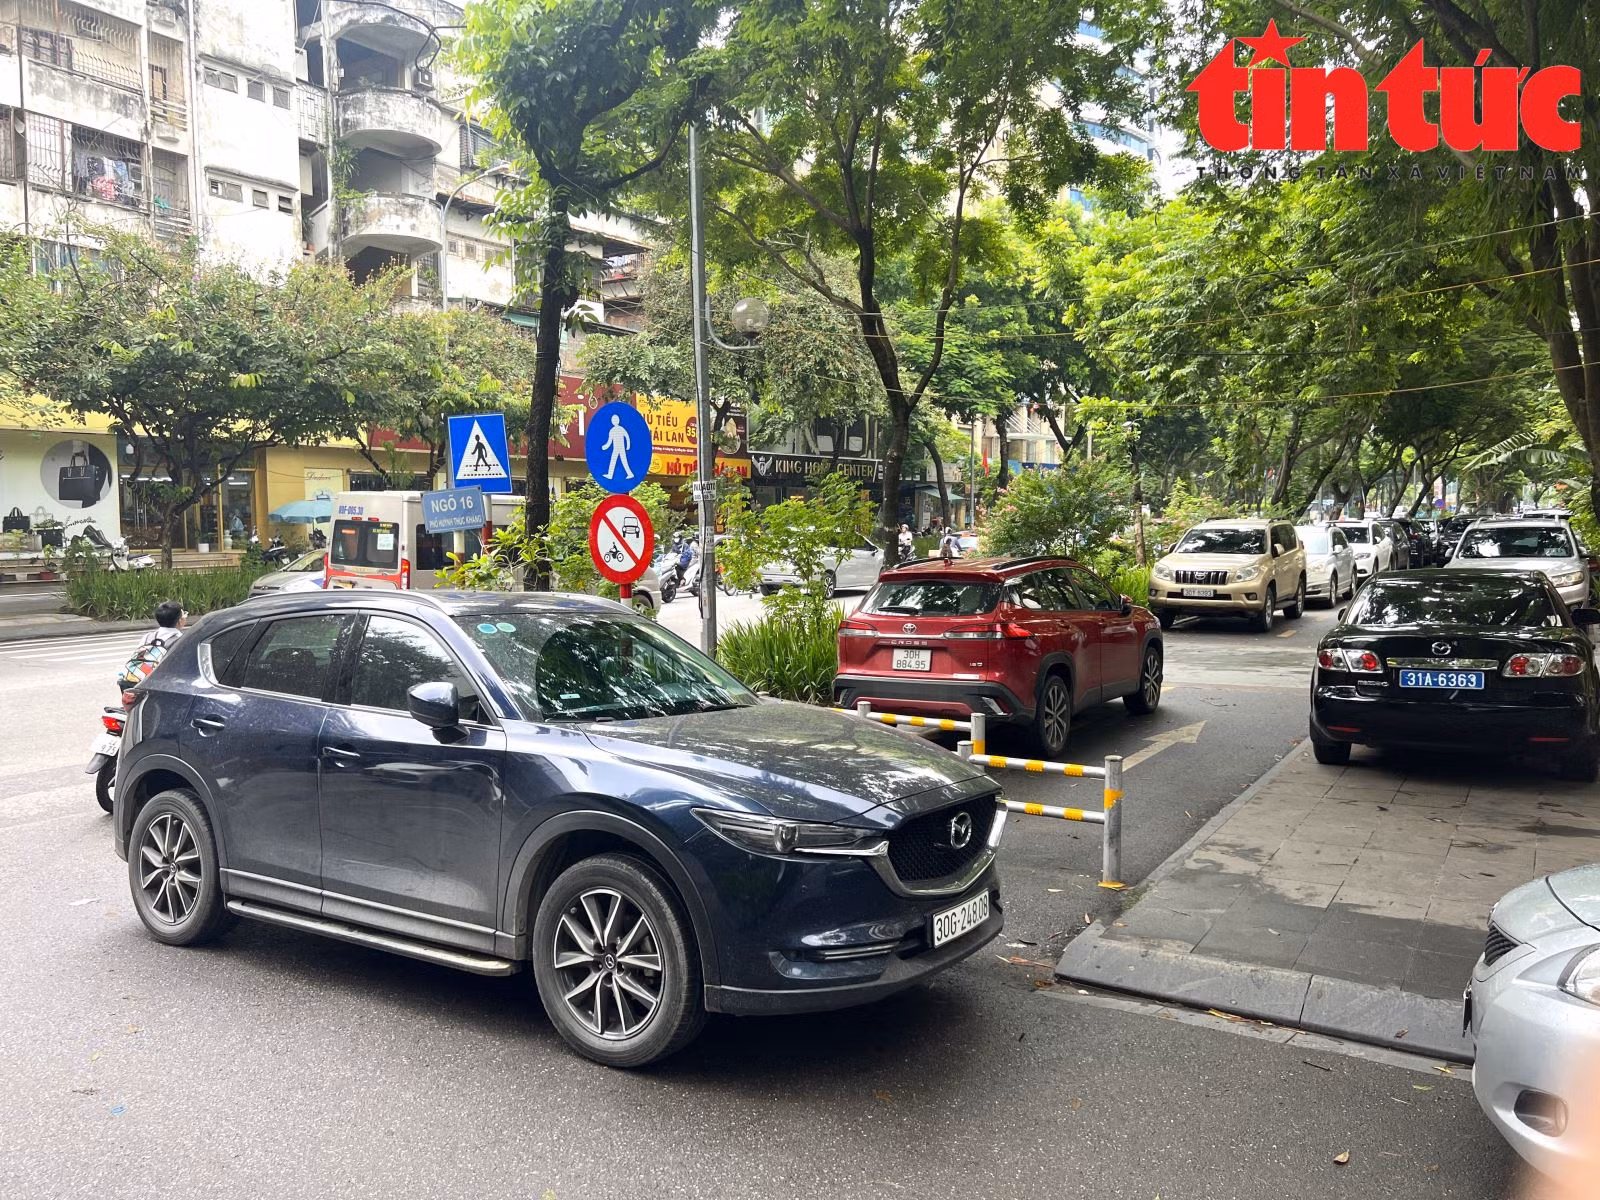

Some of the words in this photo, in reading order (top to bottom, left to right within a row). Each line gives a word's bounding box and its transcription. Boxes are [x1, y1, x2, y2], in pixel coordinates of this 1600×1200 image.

[656, 411, 678, 428] TIẾU
[666, 430, 684, 443] LAN
[775, 460, 802, 474] KING
[837, 463, 874, 477] CENTER
[431, 494, 457, 513] NGÕ
[459, 496, 474, 509] 16
[903, 650, 921, 659] 30H
[896, 660, 926, 669] 884.95
[1407, 672, 1477, 687] 31A-6363
[936, 894, 988, 941] 30G-248.08
